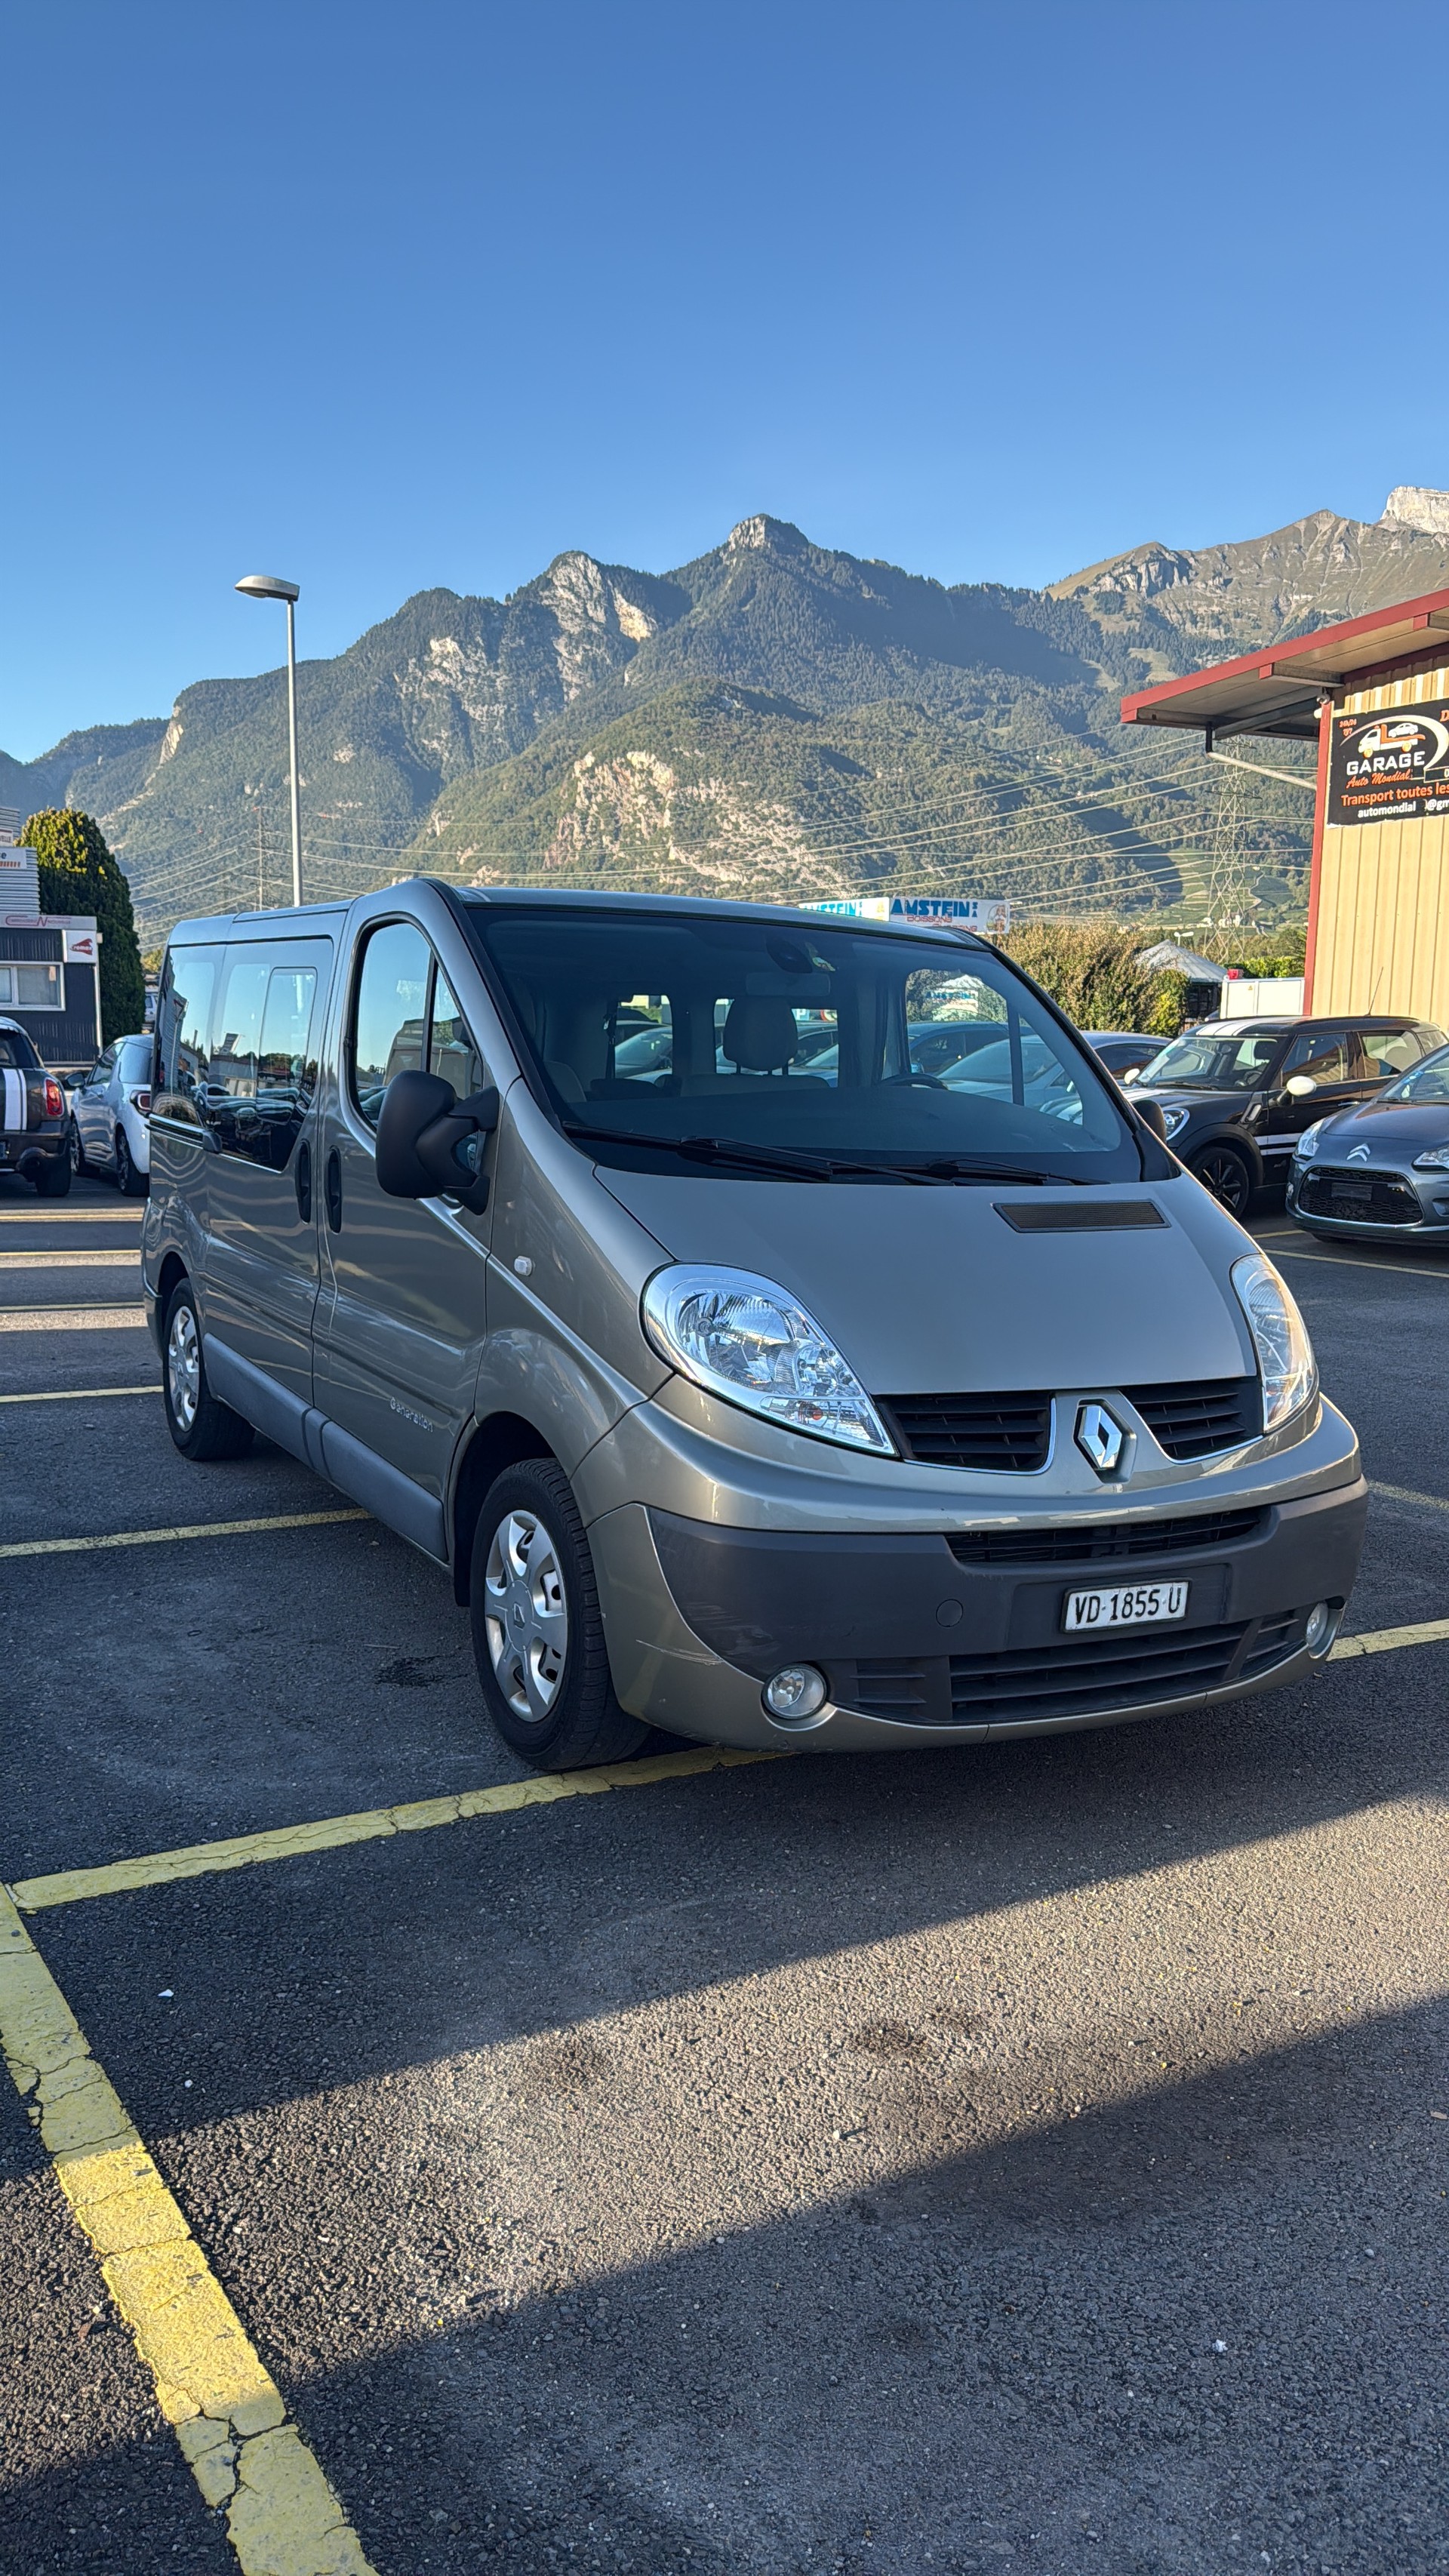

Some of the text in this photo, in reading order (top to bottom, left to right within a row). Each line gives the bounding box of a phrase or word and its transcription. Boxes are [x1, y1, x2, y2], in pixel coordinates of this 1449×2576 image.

[1346, 750, 1426, 776] GARAGE
[1346, 768, 1411, 789] Auto Mondial
[1341, 789, 1394, 807] Transport
[1396, 786, 1433, 800] toutes
[1358, 801, 1416, 819] automondial
[891, 898, 970, 918] AMSTEIN
[390, 1396, 433, 1433] Generation
